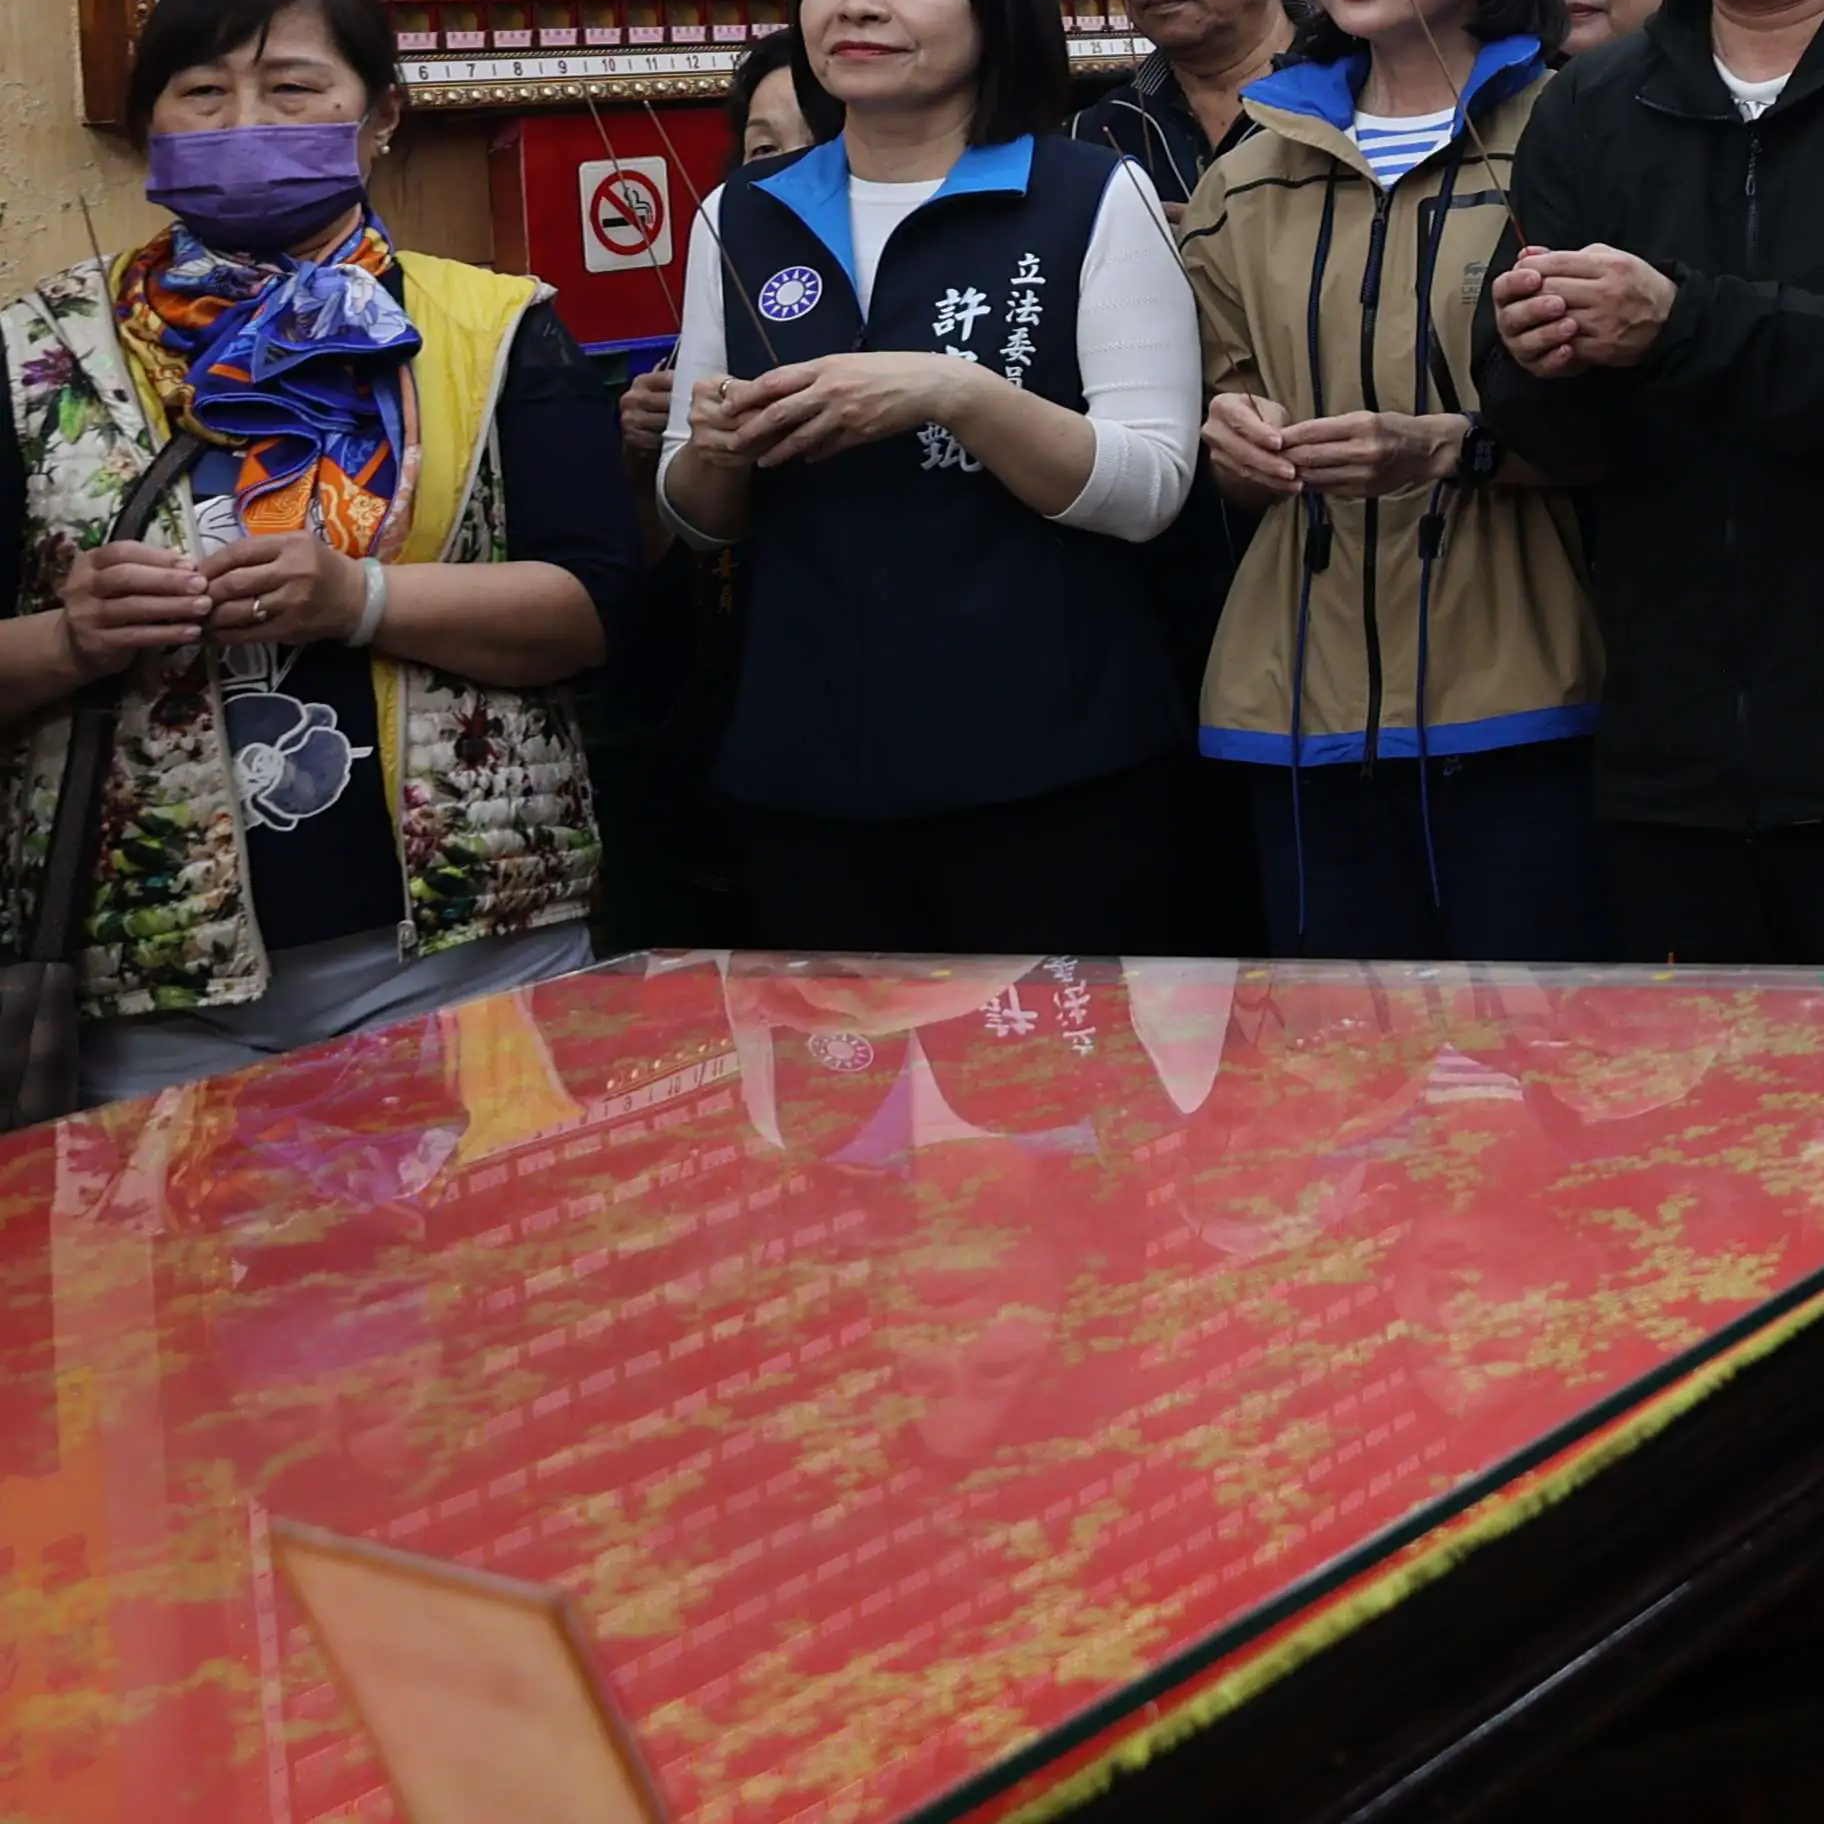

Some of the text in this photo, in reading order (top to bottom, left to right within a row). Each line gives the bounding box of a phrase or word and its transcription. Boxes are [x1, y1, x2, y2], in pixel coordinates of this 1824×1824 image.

[418, 65, 430, 80] 6
[466, 64, 476, 77] 7
[513, 62, 523, 76] 8
[558, 60, 568, 74] 9
[602, 58, 616, 71] 10
[647, 57, 658, 70] 11
[687, 55, 699, 68] 12
[916, 286, 992, 473] 許甄
